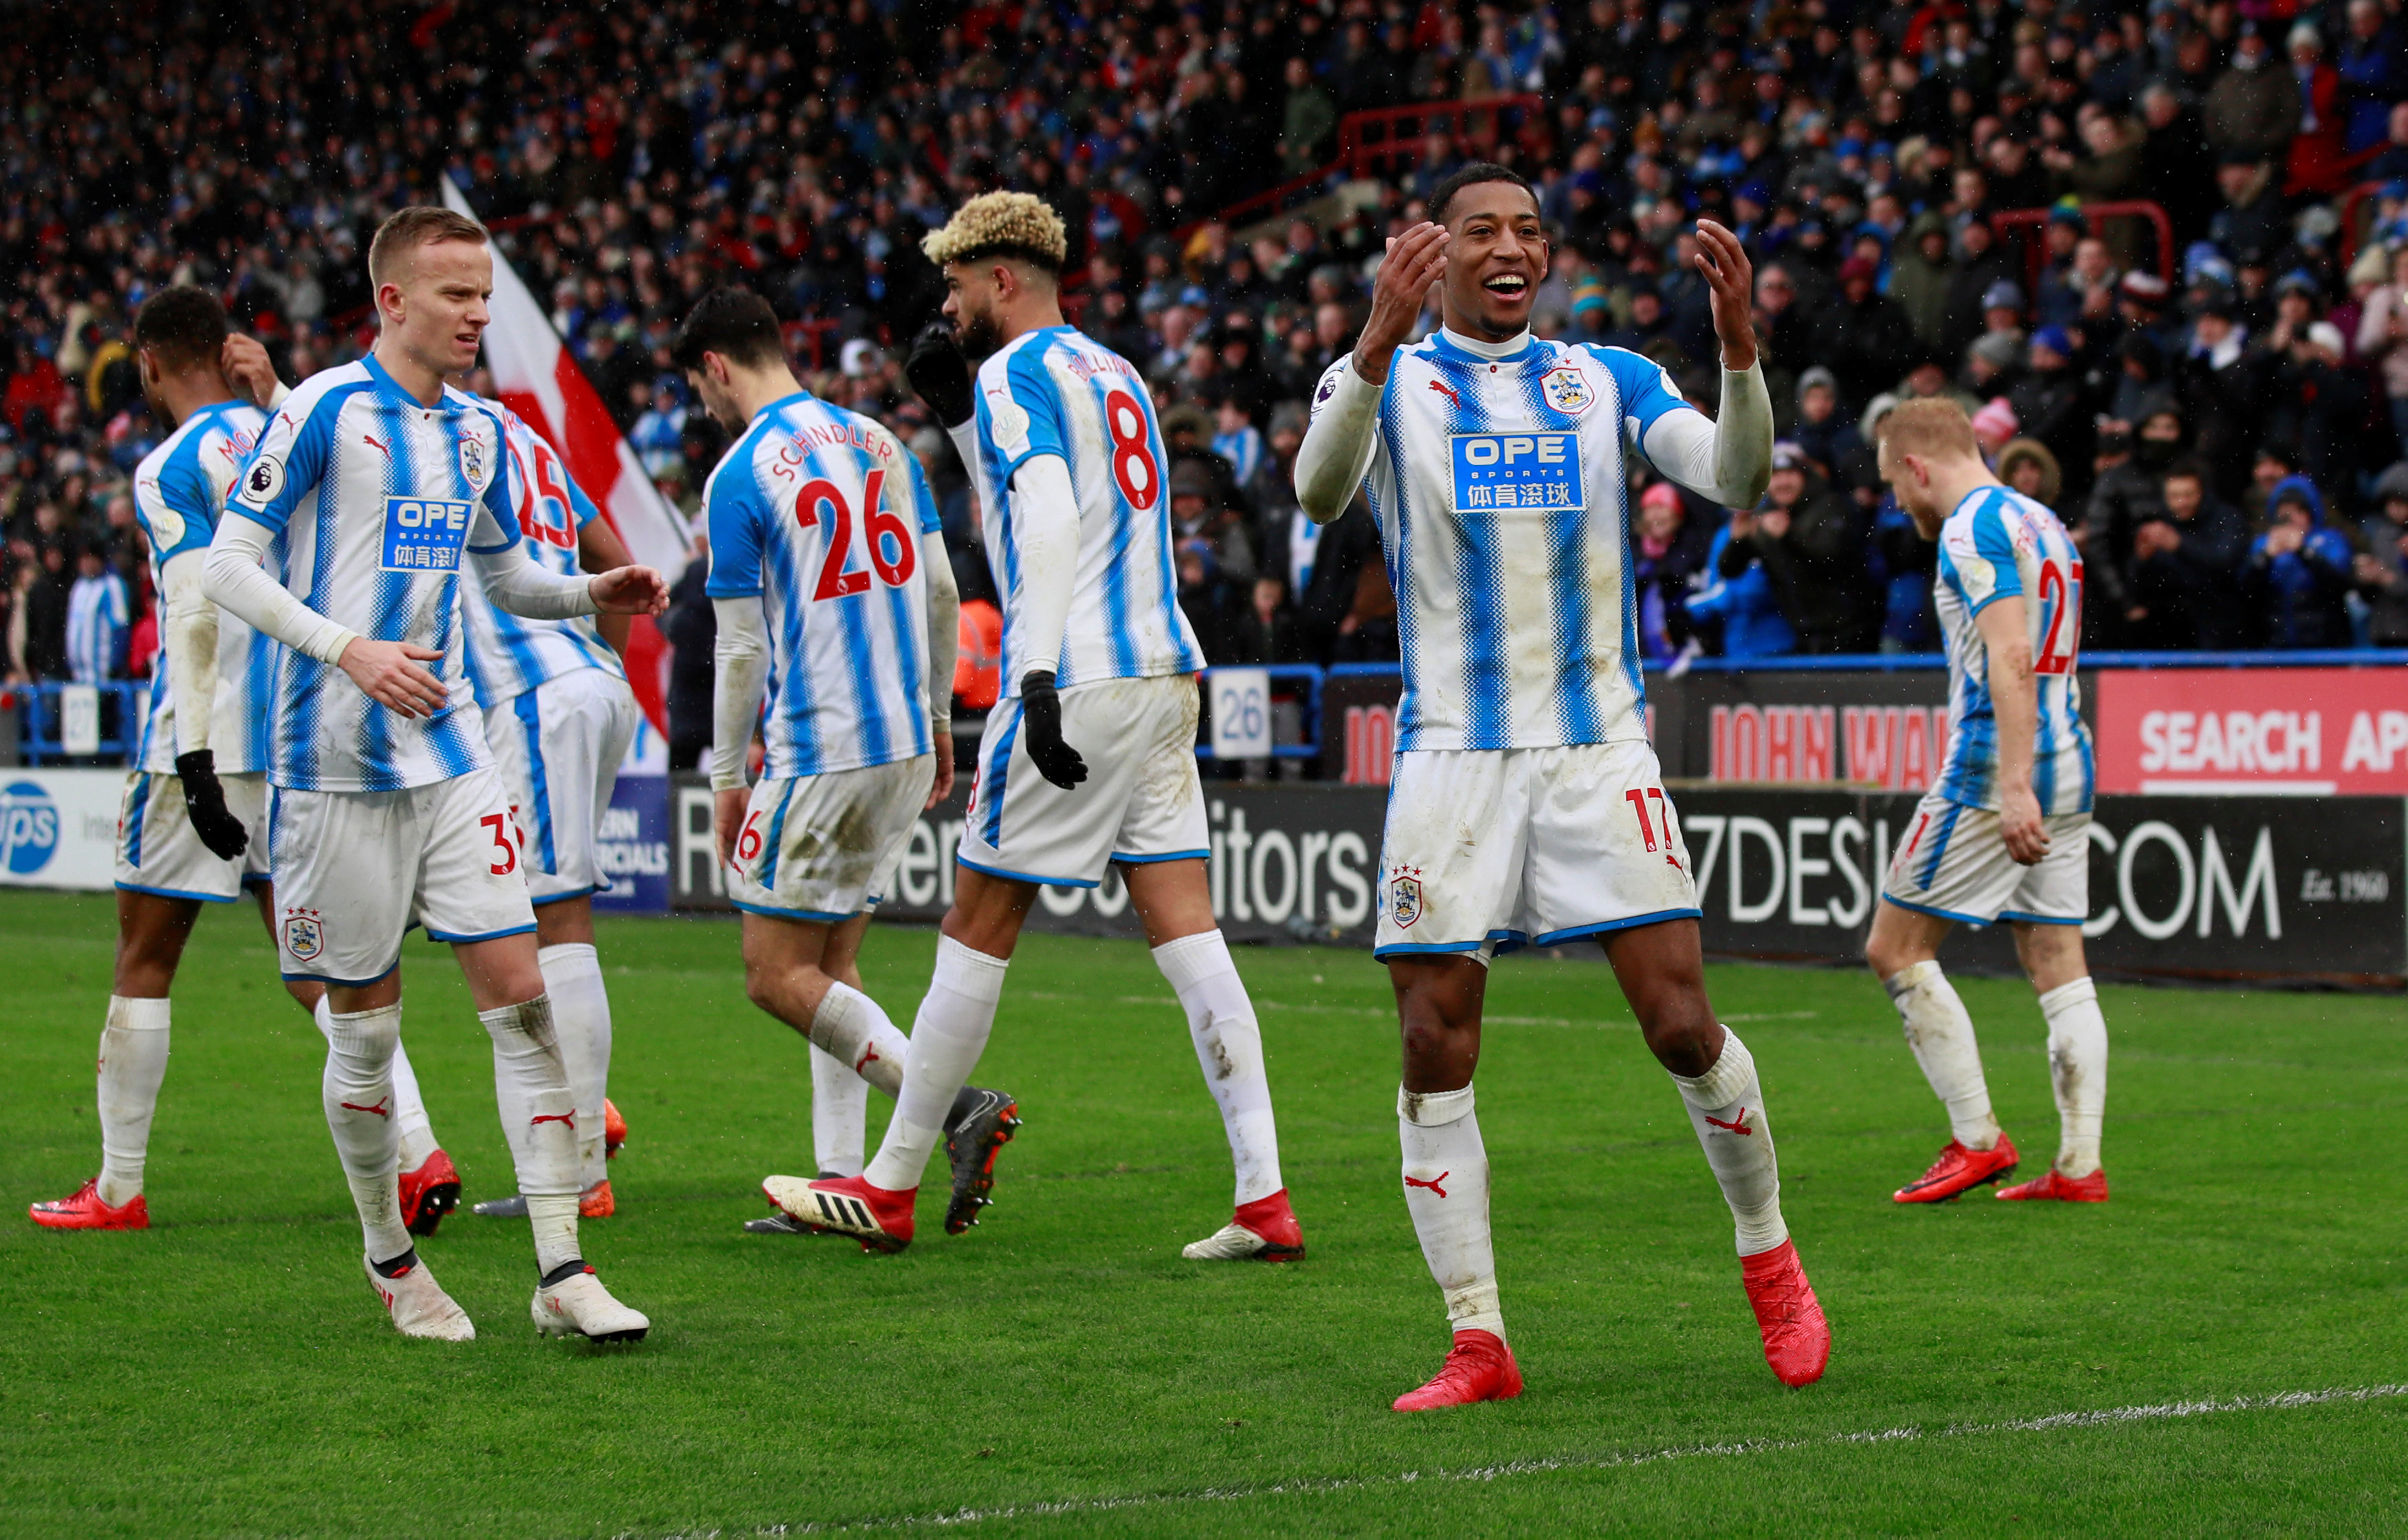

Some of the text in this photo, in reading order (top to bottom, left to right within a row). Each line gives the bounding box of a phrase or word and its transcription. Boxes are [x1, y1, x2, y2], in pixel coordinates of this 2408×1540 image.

[217, 427, 262, 465] MO
[773, 424, 893, 482] SCHINDLER
[1106, 389, 1160, 511] 8
[1465, 437, 1567, 466] OPE
[1471, 469, 1565, 480] SPORTS
[397, 502, 466, 531] OPE
[1468, 482, 1571, 508] 体育滚球
[795, 466, 916, 602] 26
[1221, 686, 1262, 740] 26
[1708, 703, 1836, 782] JOHN
[2138, 709, 2408, 773] SEARCH AP
[1342, 705, 1399, 785] JO
[480, 813, 516, 875] 3
[1625, 787, 1673, 853] 17
